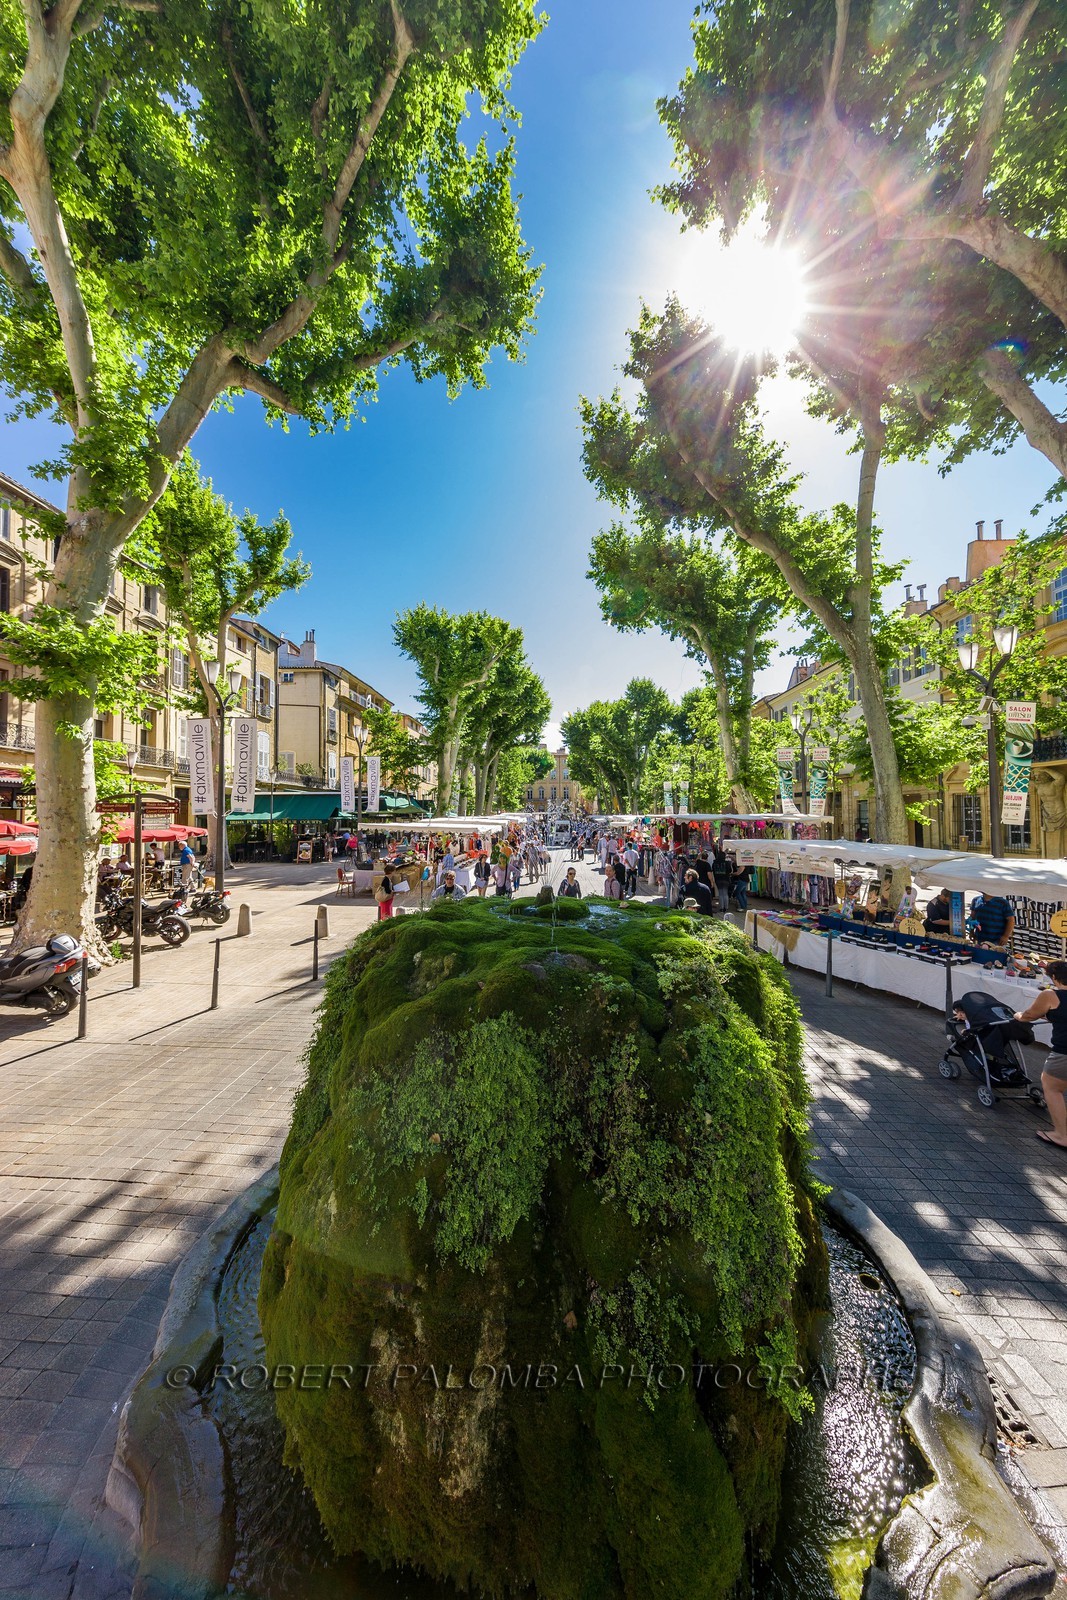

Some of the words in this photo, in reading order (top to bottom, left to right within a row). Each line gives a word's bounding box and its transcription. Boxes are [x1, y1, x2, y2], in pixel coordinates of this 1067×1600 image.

[192, 724, 207, 803] #aixmaville
[234, 723, 249, 802] #aixmaville
[342, 760, 351, 806] #aixmaville
[369, 760, 377, 806] #aixmaville
